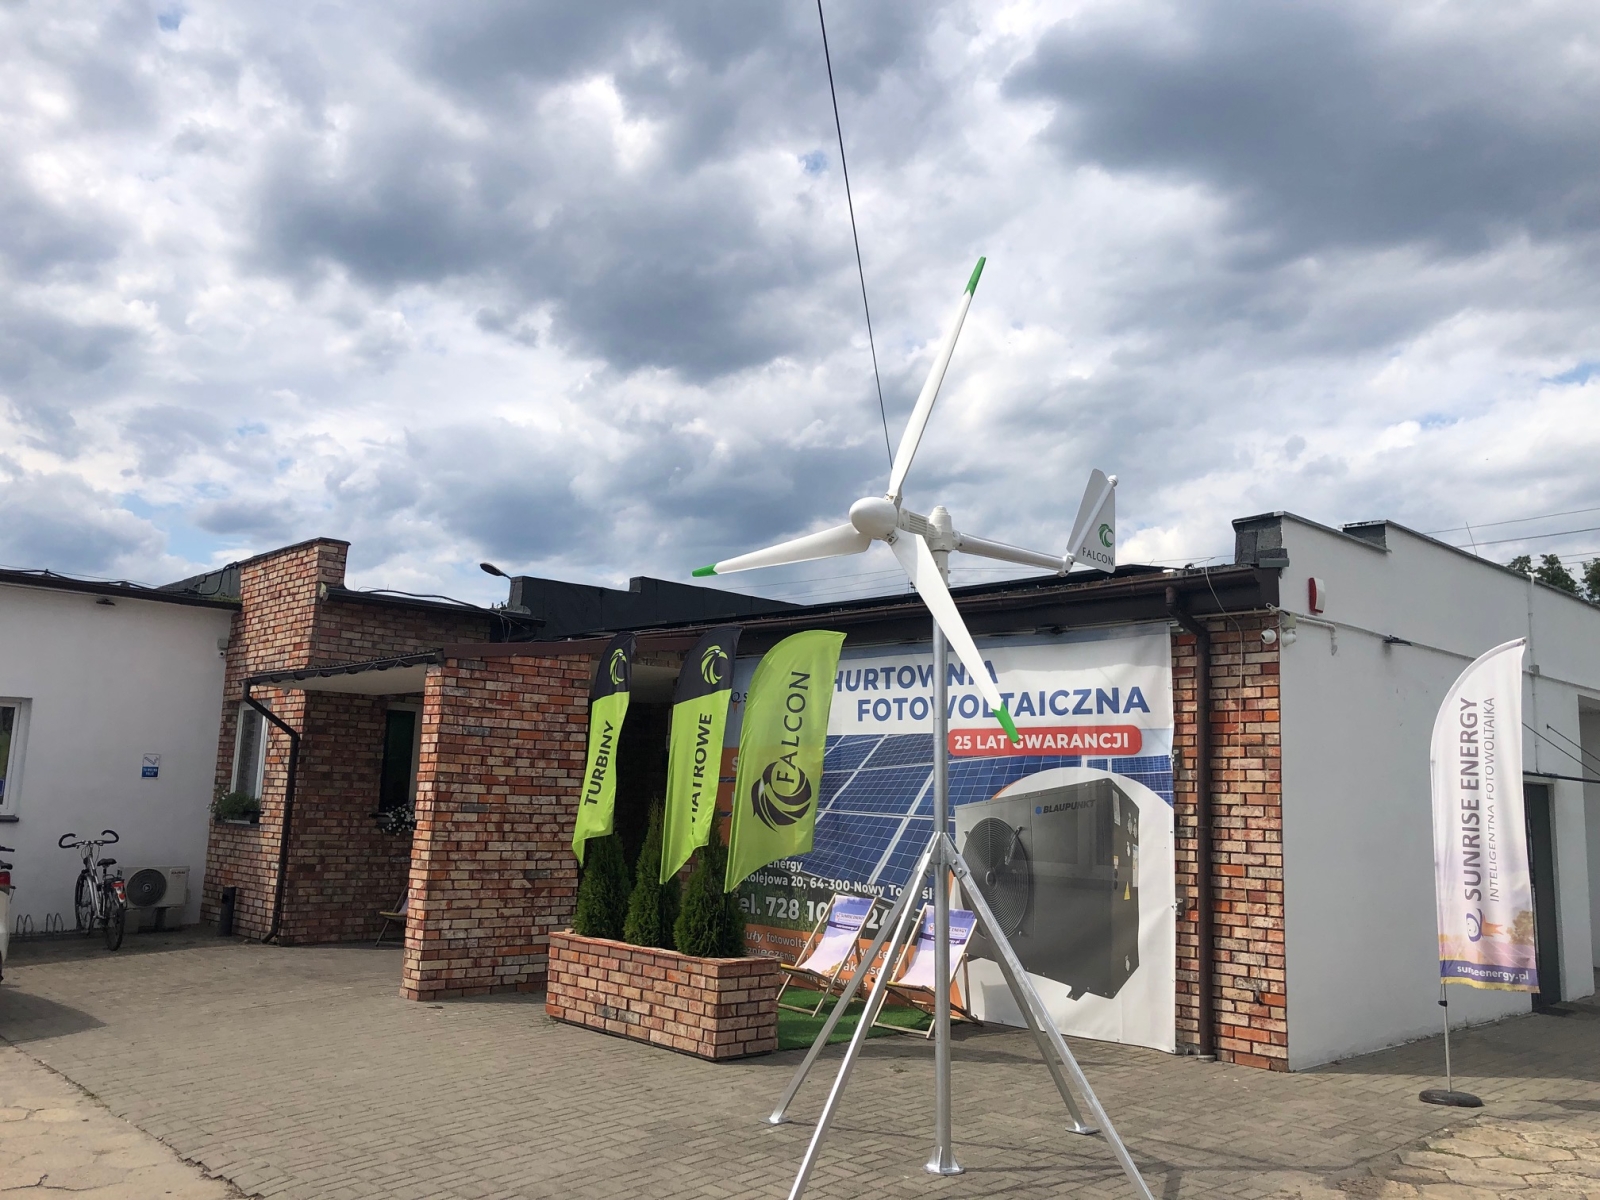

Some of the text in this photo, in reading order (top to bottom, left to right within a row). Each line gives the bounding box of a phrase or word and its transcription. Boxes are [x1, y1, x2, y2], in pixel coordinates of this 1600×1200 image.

[1082, 546, 1114, 566] FALCON
[776, 670, 811, 783] FALCON
[954, 732, 1129, 750] 25 LAT GWARANCJI
[583, 719, 615, 807] TURBINY
[691, 713, 713, 836] IATROWE
[1043, 799, 1096, 814] BLAUPUNKT
[1459, 697, 1482, 902] SUNRISE ENERGY
[1483, 697, 1500, 902] INTELIGENTNA FOTOWOLTAIKA
[735, 893, 761, 915] el.
[765, 896, 800, 920] 728
[791, 875, 806, 890] 20,
[809, 877, 851, 893] 64-300
[854, 881, 884, 897] Nowy
